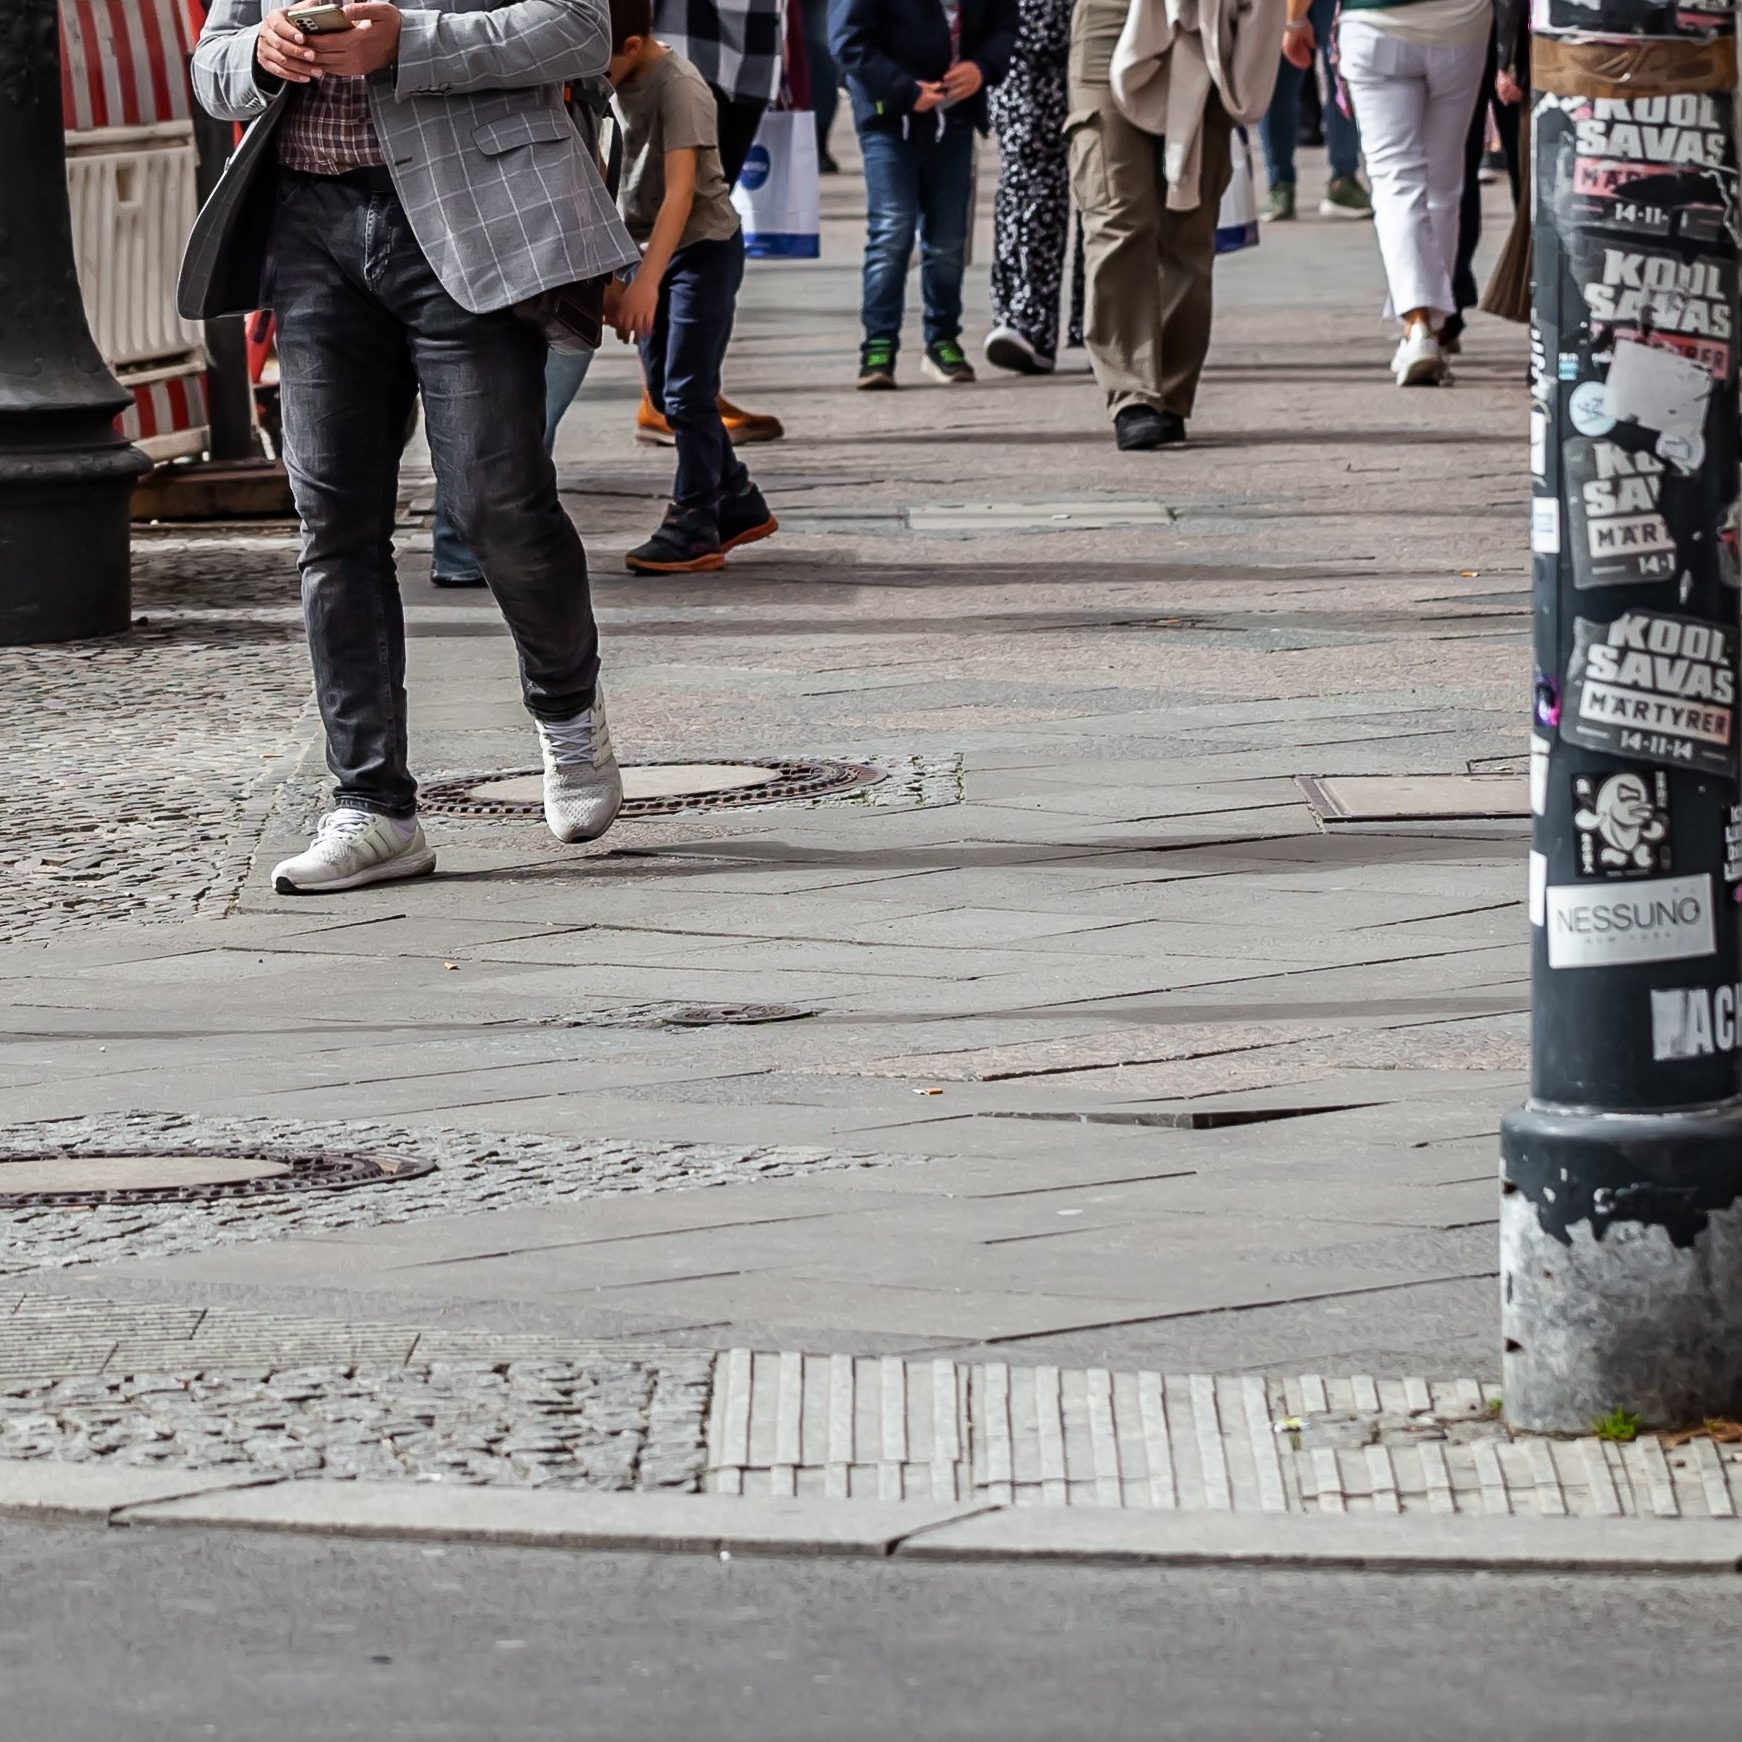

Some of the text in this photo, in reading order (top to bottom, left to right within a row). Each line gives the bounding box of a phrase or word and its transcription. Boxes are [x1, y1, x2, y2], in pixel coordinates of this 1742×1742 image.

[1594, 93, 1720, 129] KOOL
[1575, 119, 1727, 166] SAVAS
[1608, 612, 1731, 667] KOOL
[1585, 642, 1735, 705] SAVAS
[1589, 690, 1728, 735] MÄRTYRER
[1556, 895, 1702, 934] NESSUNO
